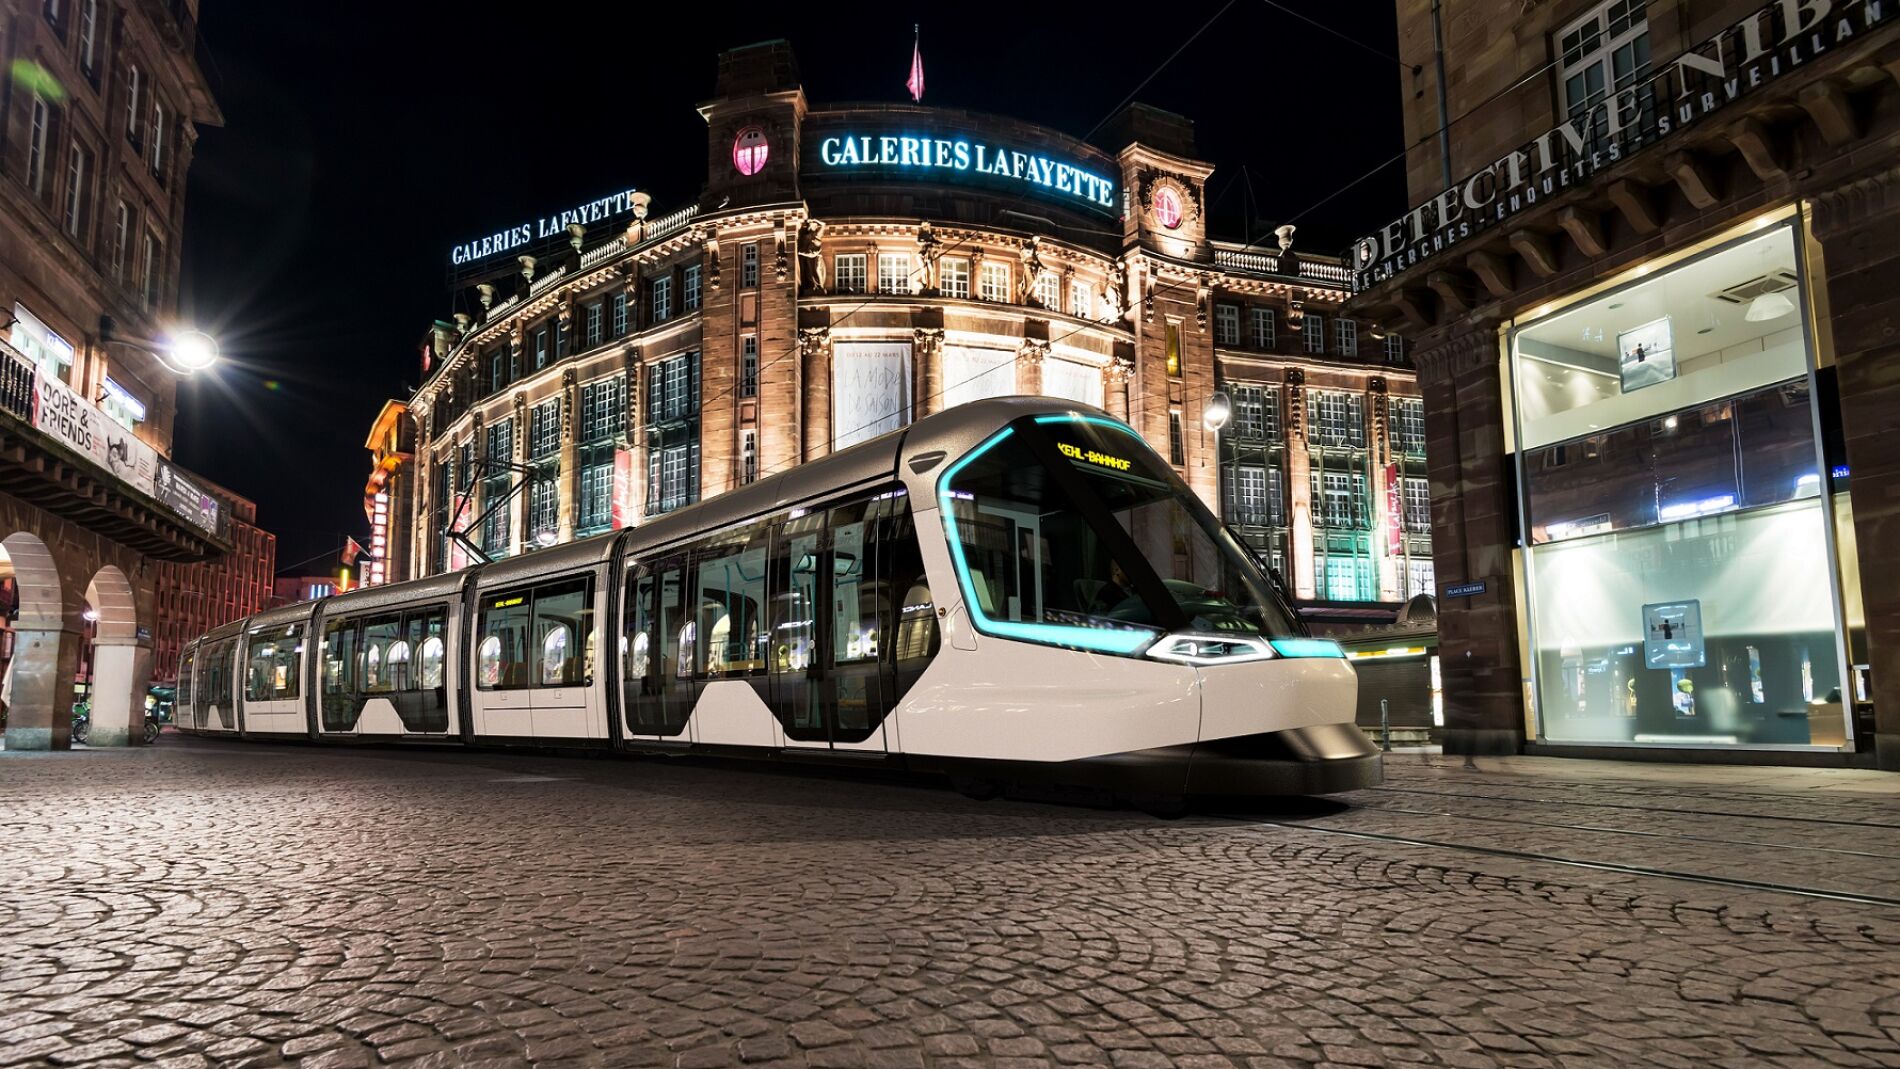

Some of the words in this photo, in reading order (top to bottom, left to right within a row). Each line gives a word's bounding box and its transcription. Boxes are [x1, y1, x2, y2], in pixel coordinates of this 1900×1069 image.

[822, 136, 970, 170] GALERIES
[974, 144, 1114, 208] LAFAYETTE
[1351, 84, 1643, 273] DETECTIVE
[452, 223, 531, 265] GALERIES
[538, 188, 637, 239] LAFAYETTE
[1352, 221, 1469, 295] RECHERCHES
[1496, 142, 1622, 220] ENQUETES
[41, 405, 92, 451] FRIENDS
[80, 408, 89, 430] &
[1057, 441, 1131, 471] KEHL-BAHNHOF
